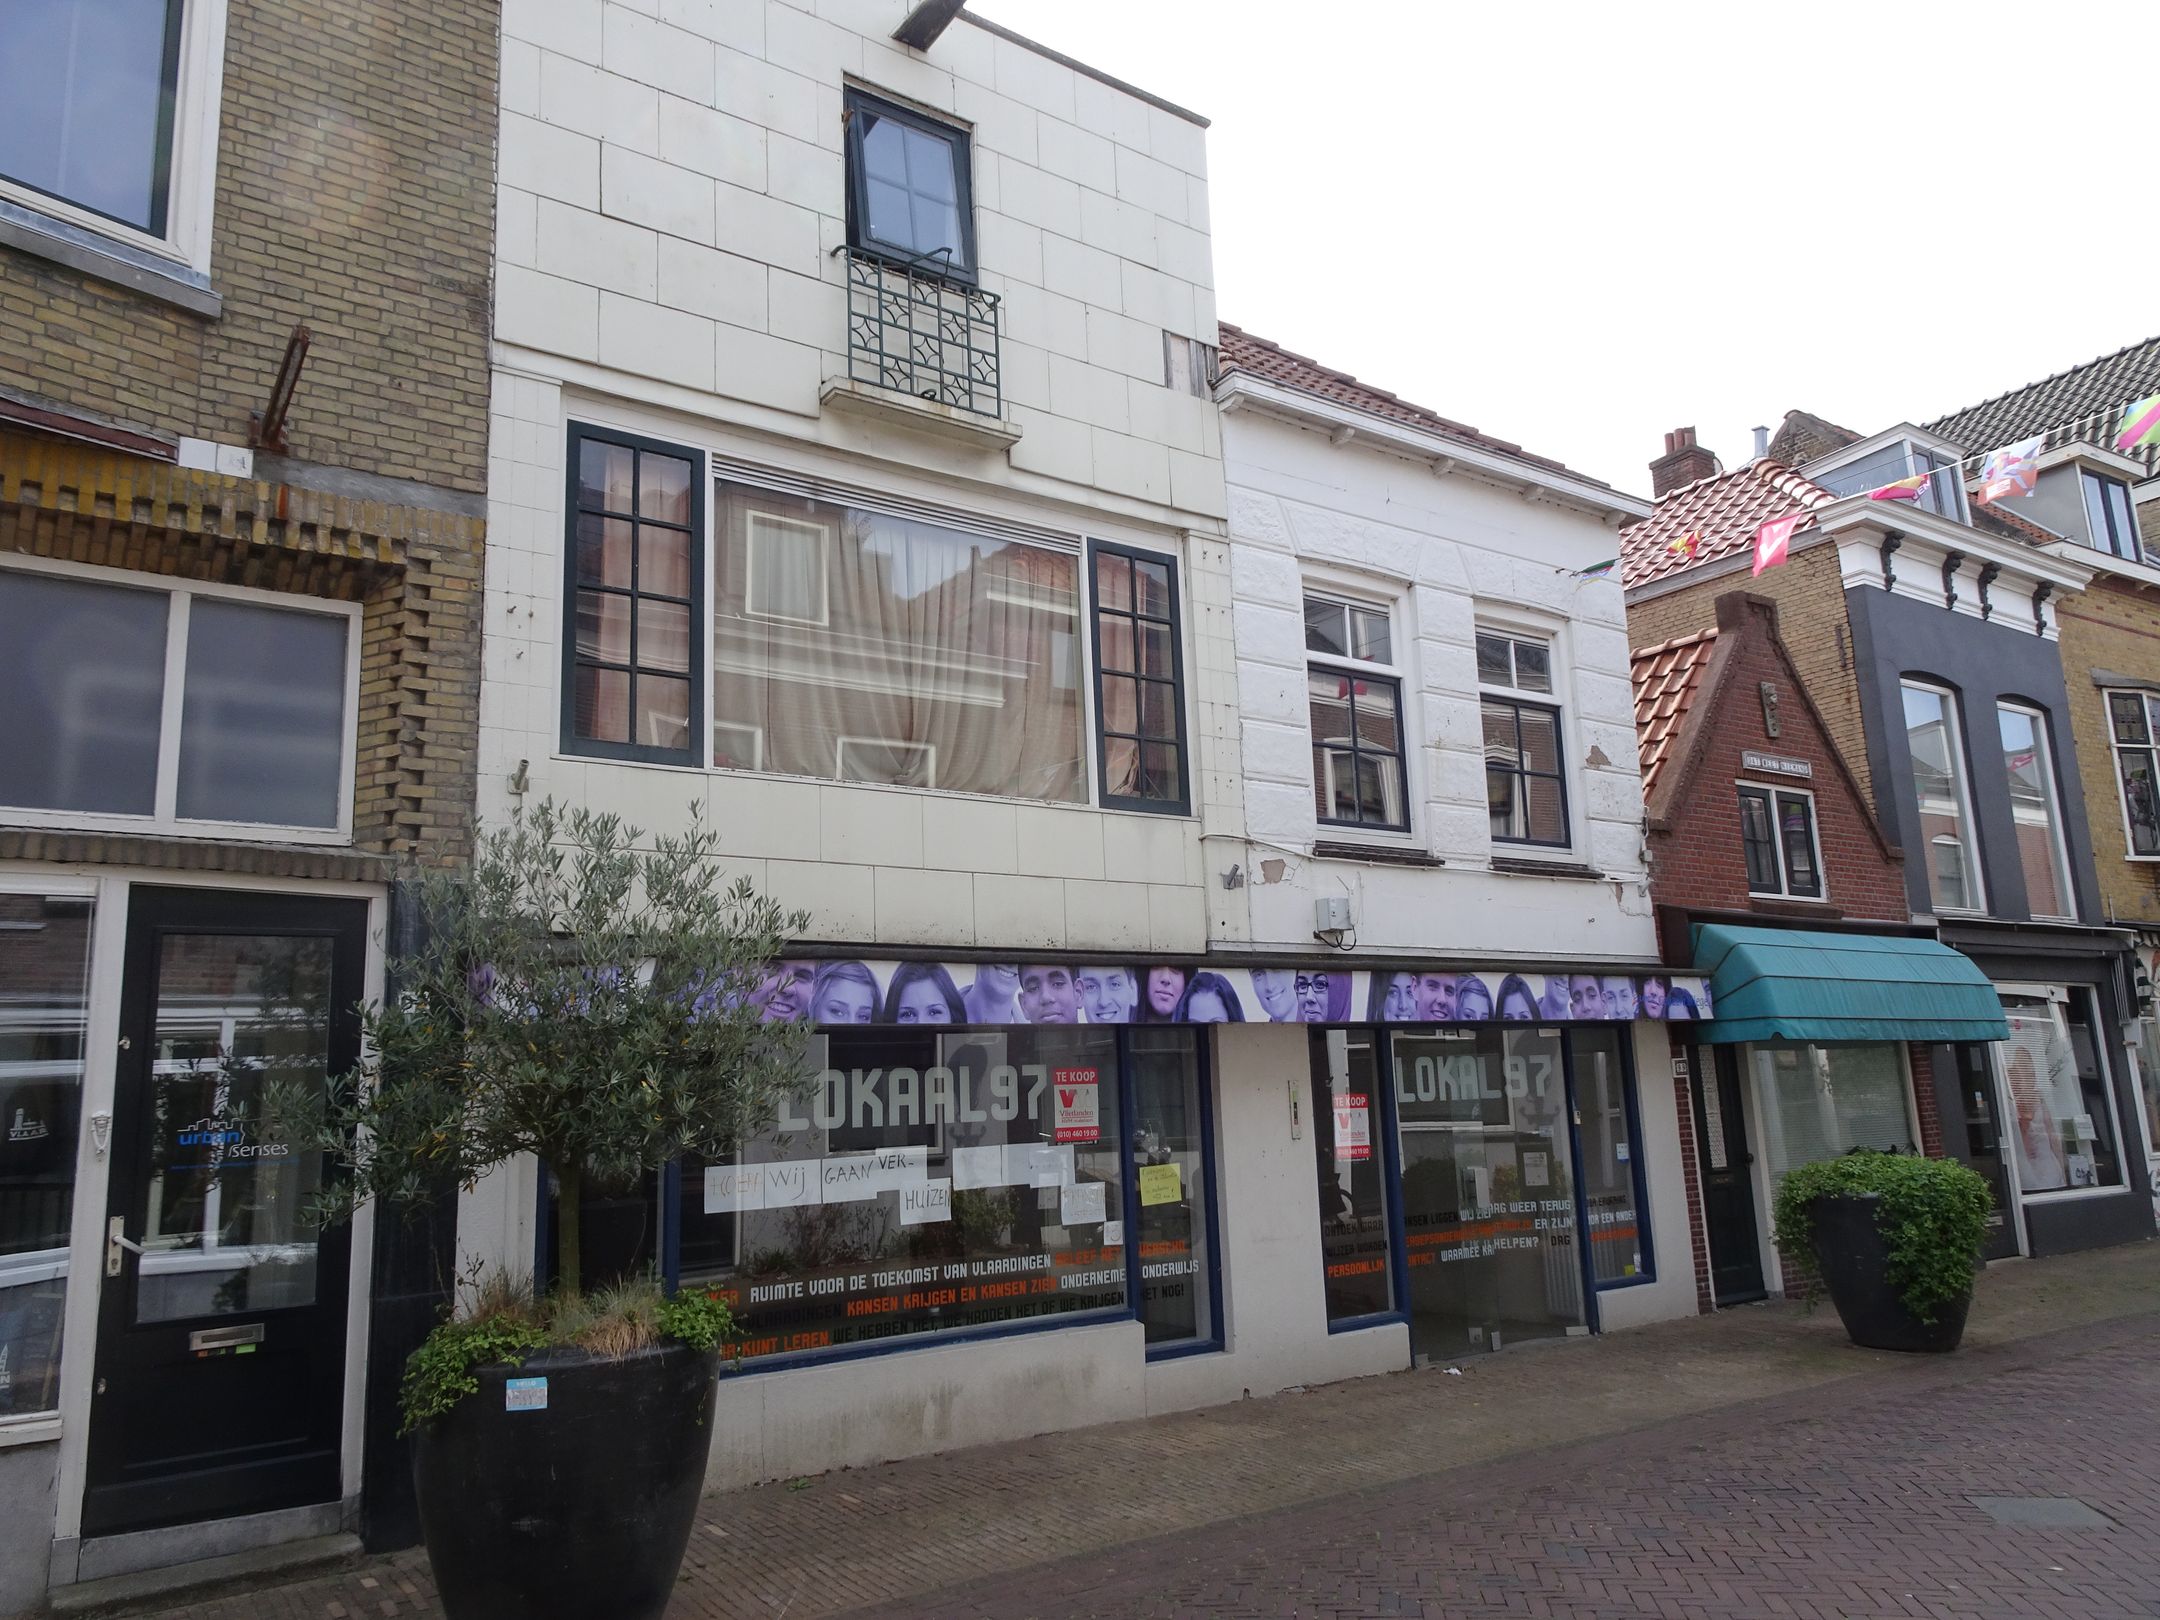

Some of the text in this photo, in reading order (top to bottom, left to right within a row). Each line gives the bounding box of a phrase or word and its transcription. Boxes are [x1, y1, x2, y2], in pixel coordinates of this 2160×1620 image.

[1056, 1071, 1096, 1082] TE KOOP
[1335, 1096, 1366, 1107] TE KOOP
[179, 1130, 241, 1146] urban
[1057, 1130, 1072, 1139] (010)
[1072, 1130, 1083, 1138] 460
[1090, 1129, 1098, 1137] 00
[231, 1143, 289, 1158] senses
[824, 1160, 873, 1185] GAAN
[878, 1152, 915, 1171] VER-
[1509, 1201, 1537, 1214] WEER
[1540, 1199, 1572, 1212] TERUG
[1534, 1218, 1548, 1230] ER
[1600, 1211, 1615, 1224] EEN
[1440, 1246, 1480, 1263] WAARMEE
[1493, 1236, 1540, 1250] HELPEN?
[1551, 1235, 1571, 1247] DAG
[750, 1282, 804, 1303] RUIMTE
[809, 1277, 844, 1296] VOOR
[850, 1275, 867, 1291] DE
[872, 1266, 939, 1288] TOEKOMST
[943, 1262, 967, 1280] VAN
[972, 1253, 1051, 1276] VLAARDINGEN
[847, 1295, 898, 1318] KANSEN
[904, 1288, 956, 1310] KRIJGEN
[960, 1286, 977, 1303] EN
[981, 1280, 1027, 1300] KANSEN
[1031, 1275, 1057, 1294] ZIEN
[1142, 1259, 1200, 1279] ONDERWIJS
[742, 1337, 778, 1356] KUNT
[783, 1330, 832, 1352] LEREN.
[833, 1326, 853, 1344] WE
[858, 1320, 909, 1340] HEBBEN
[943, 1313, 962, 1328] WE
[966, 1306, 1012, 1325] HADDEN
[1016, 1303, 1037, 1318] HET
[1041, 1300, 1056, 1314] OF
[1061, 1296, 1077, 1312] WE
[1081, 1291, 1125, 1310] KRIJGEN
[1161, 1283, 1185, 1299] NOG!
